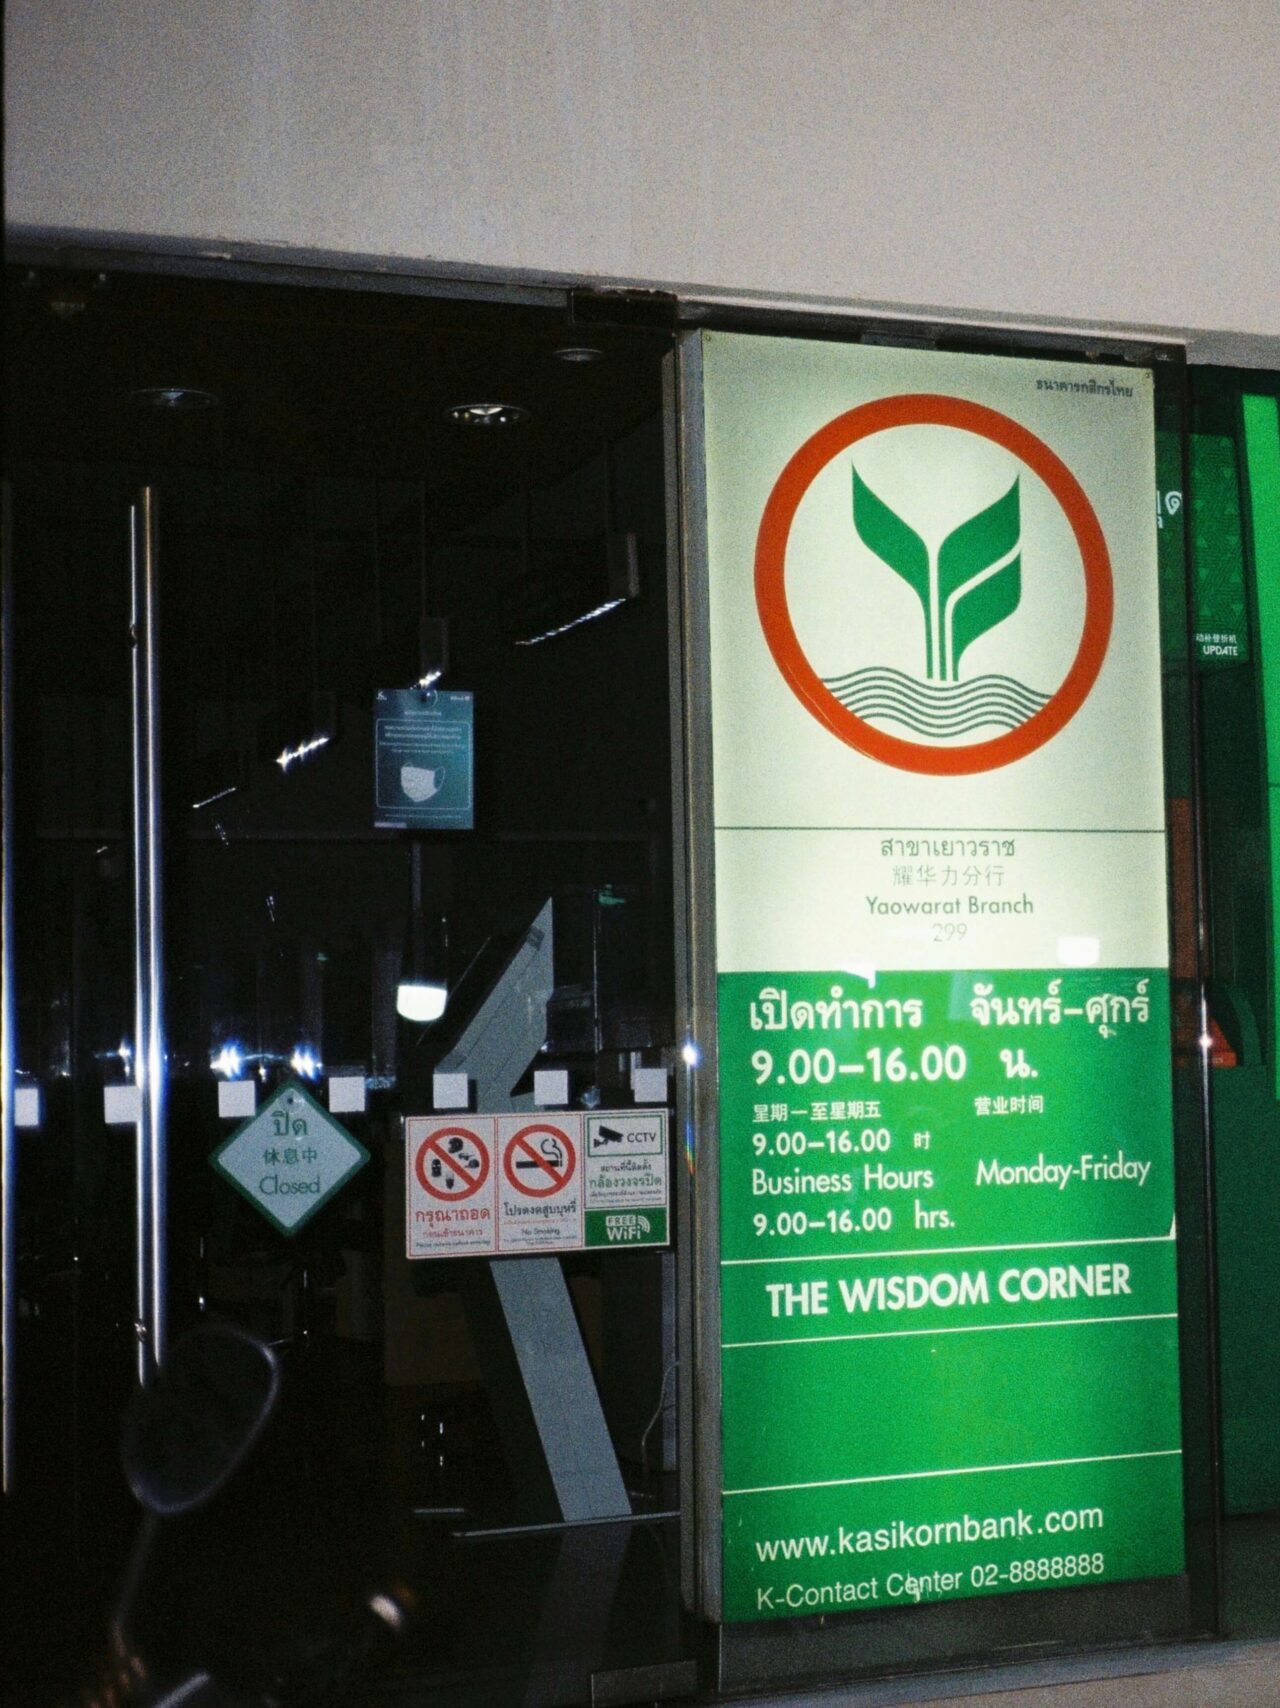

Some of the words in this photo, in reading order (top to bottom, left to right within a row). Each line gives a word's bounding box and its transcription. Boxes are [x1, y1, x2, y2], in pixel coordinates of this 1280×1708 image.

[1203, 645, 1239, 656] UPDATE
[881, 838, 1016, 857] สาขาเยาวราช
[892, 865, 1005, 887] 耀华力分行
[866, 896, 961, 915] Yaowarat
[968, 893, 1034, 914] Branch
[932, 922, 968, 943] 299
[750, 985, 923, 1031] เปิดทำการ
[999, 1047, 1039, 1079] น.
[974, 1095, 1044, 1116] 营业时间
[271, 1110, 307, 1136] ปิด
[626, 1132, 656, 1143] CCTV
[263, 1147, 318, 1166] 休息中
[752, 1167, 853, 1196] Business
[864, 1162, 934, 1191] Hours
[975, 1150, 1152, 1190] Monday-Friday
[259, 1174, 320, 1196] Closed
[415, 1207, 490, 1228] กรุณาถอด
[607, 1215, 635, 1226] FREE
[914, 1199, 956, 1229] hrs.
[607, 1226, 641, 1241] WiFi
[766, 1280, 829, 1318] THE
[838, 1271, 990, 1314] WISDOM
[999, 1263, 1132, 1303] CORNER
[756, 1507, 1104, 1562] www.kasikornbank.com
[757, 1578, 878, 1611] K-Contact
[886, 1570, 963, 1602] Center
[970, 1553, 1105, 1589] 02-8888888
